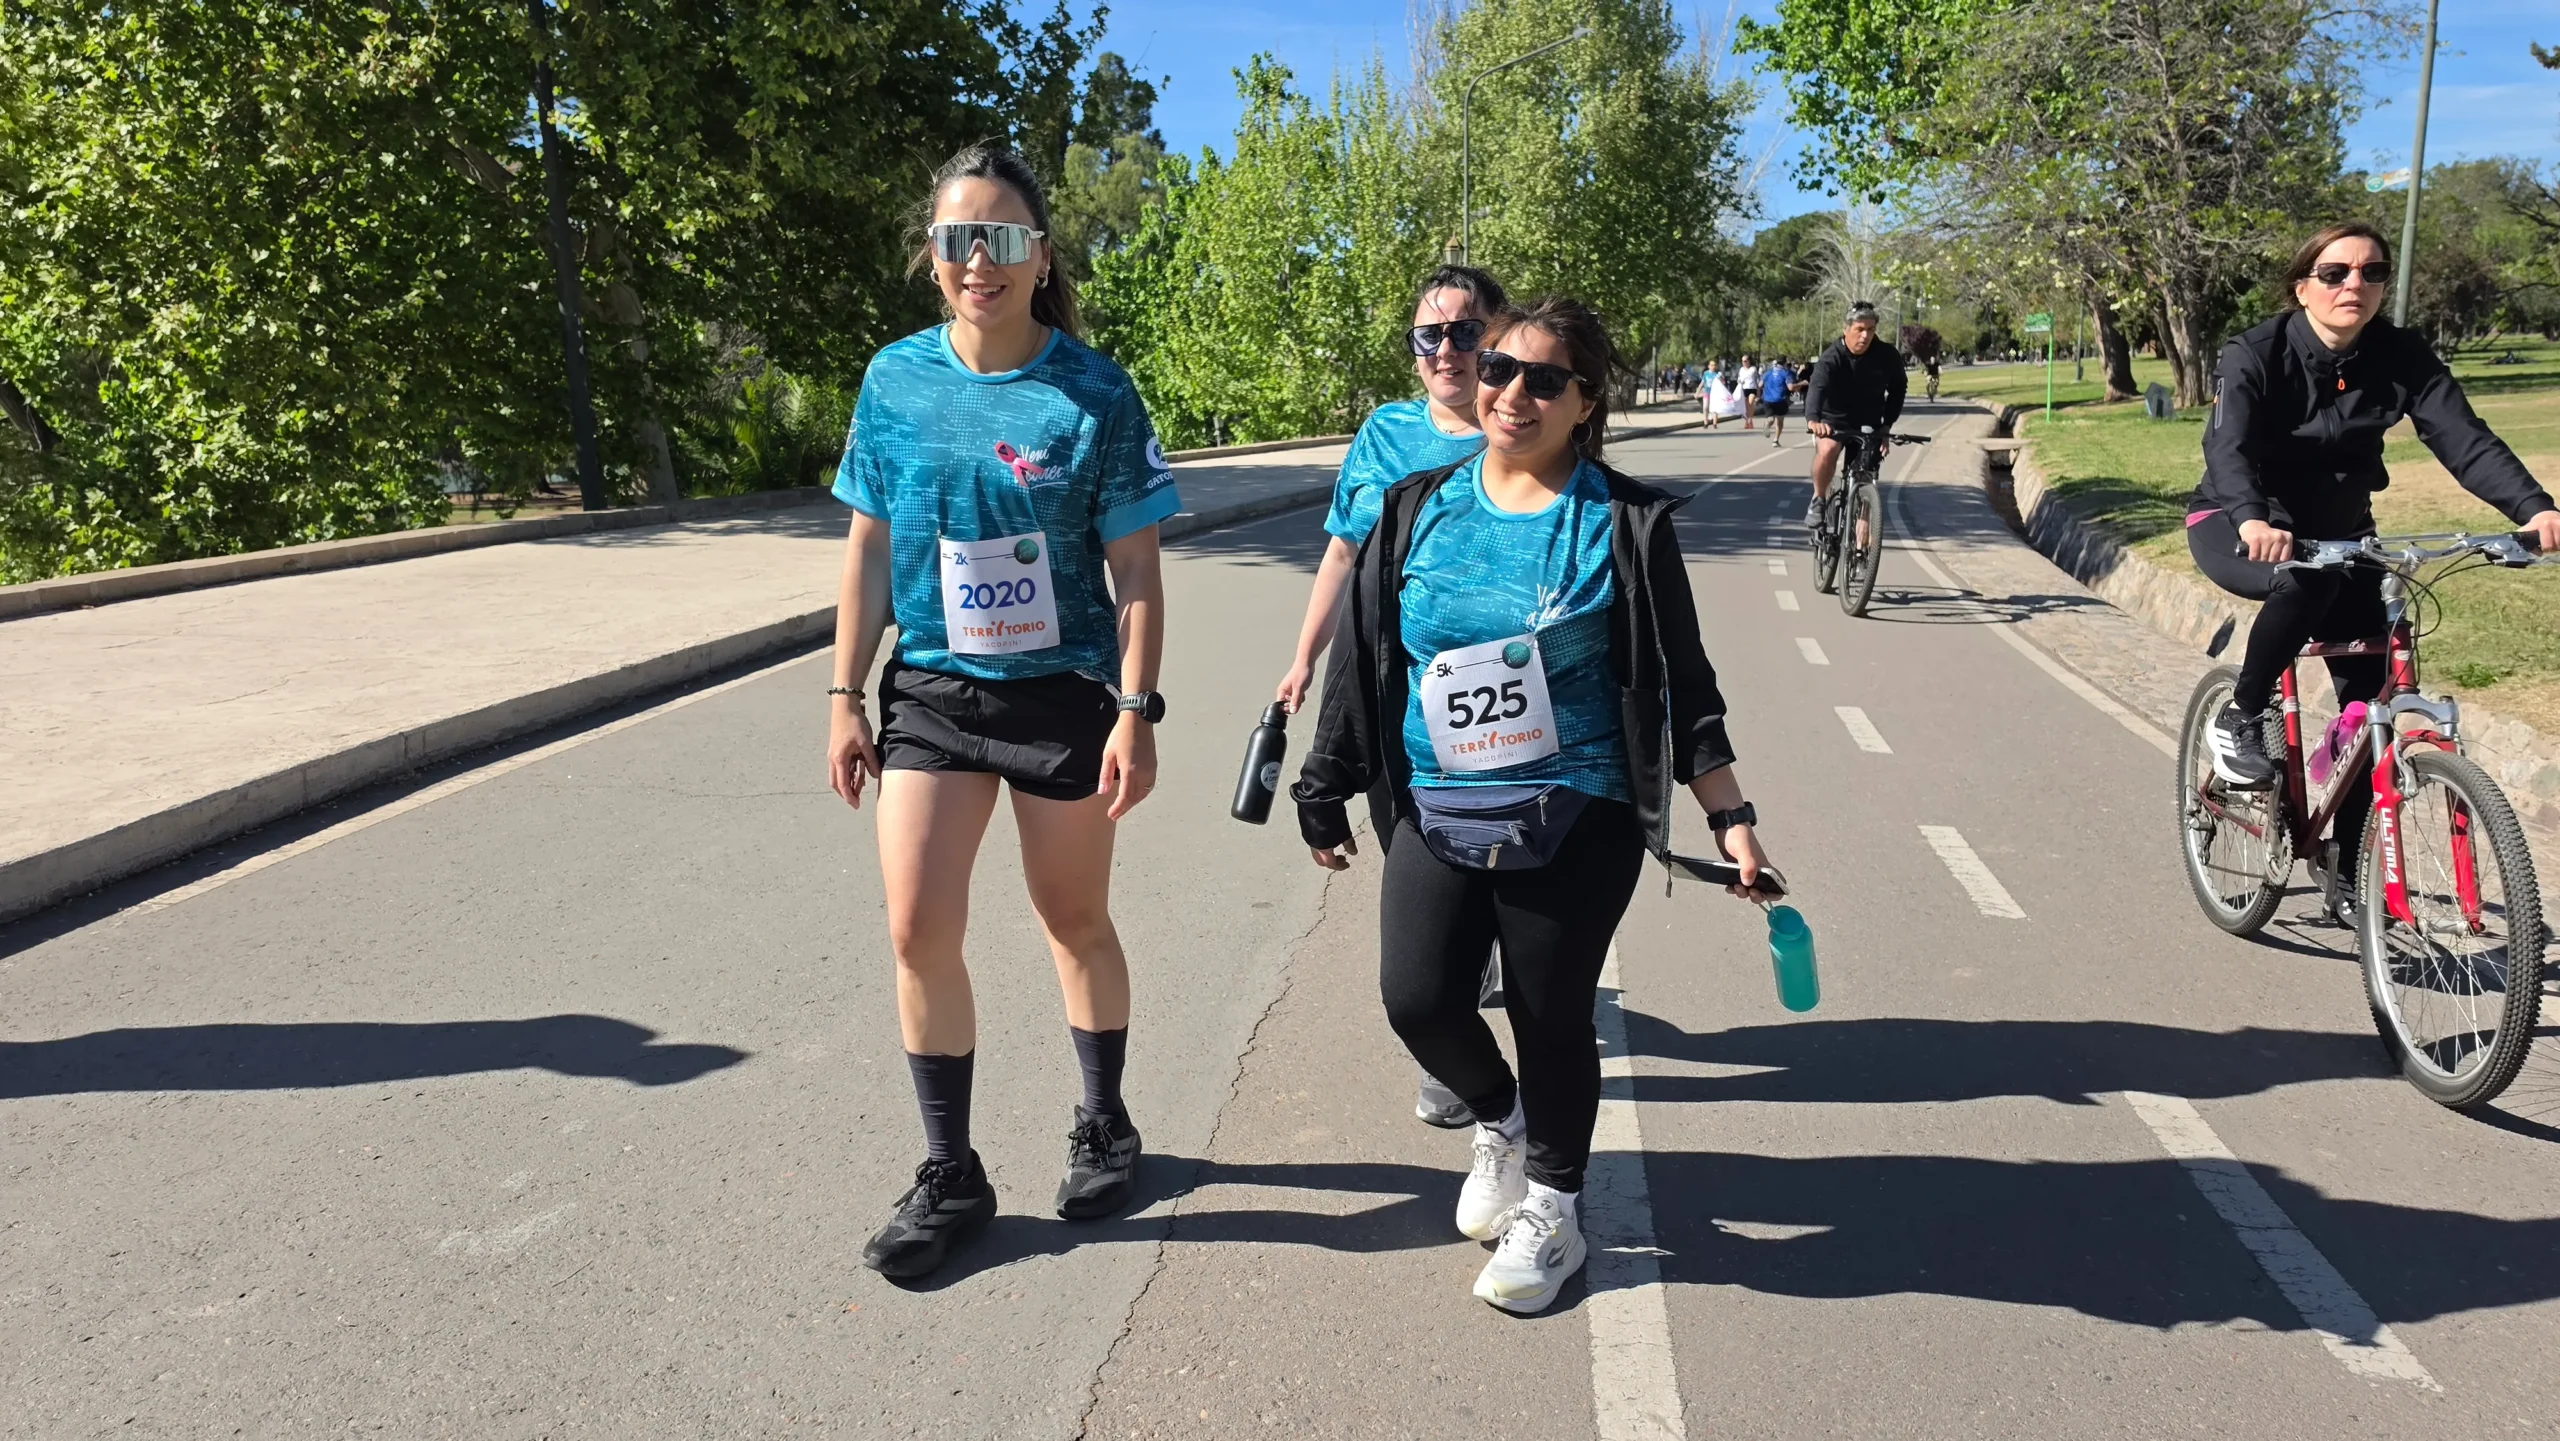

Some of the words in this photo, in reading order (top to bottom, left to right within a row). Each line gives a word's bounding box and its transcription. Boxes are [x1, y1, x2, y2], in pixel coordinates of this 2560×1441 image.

[953, 552, 969, 566] 2k
[958, 577, 1036, 610] 2020
[1436, 663, 1454, 678] 5k
[1447, 679, 1528, 729] 525
[2360, 859, 2369, 905] HARTEX
